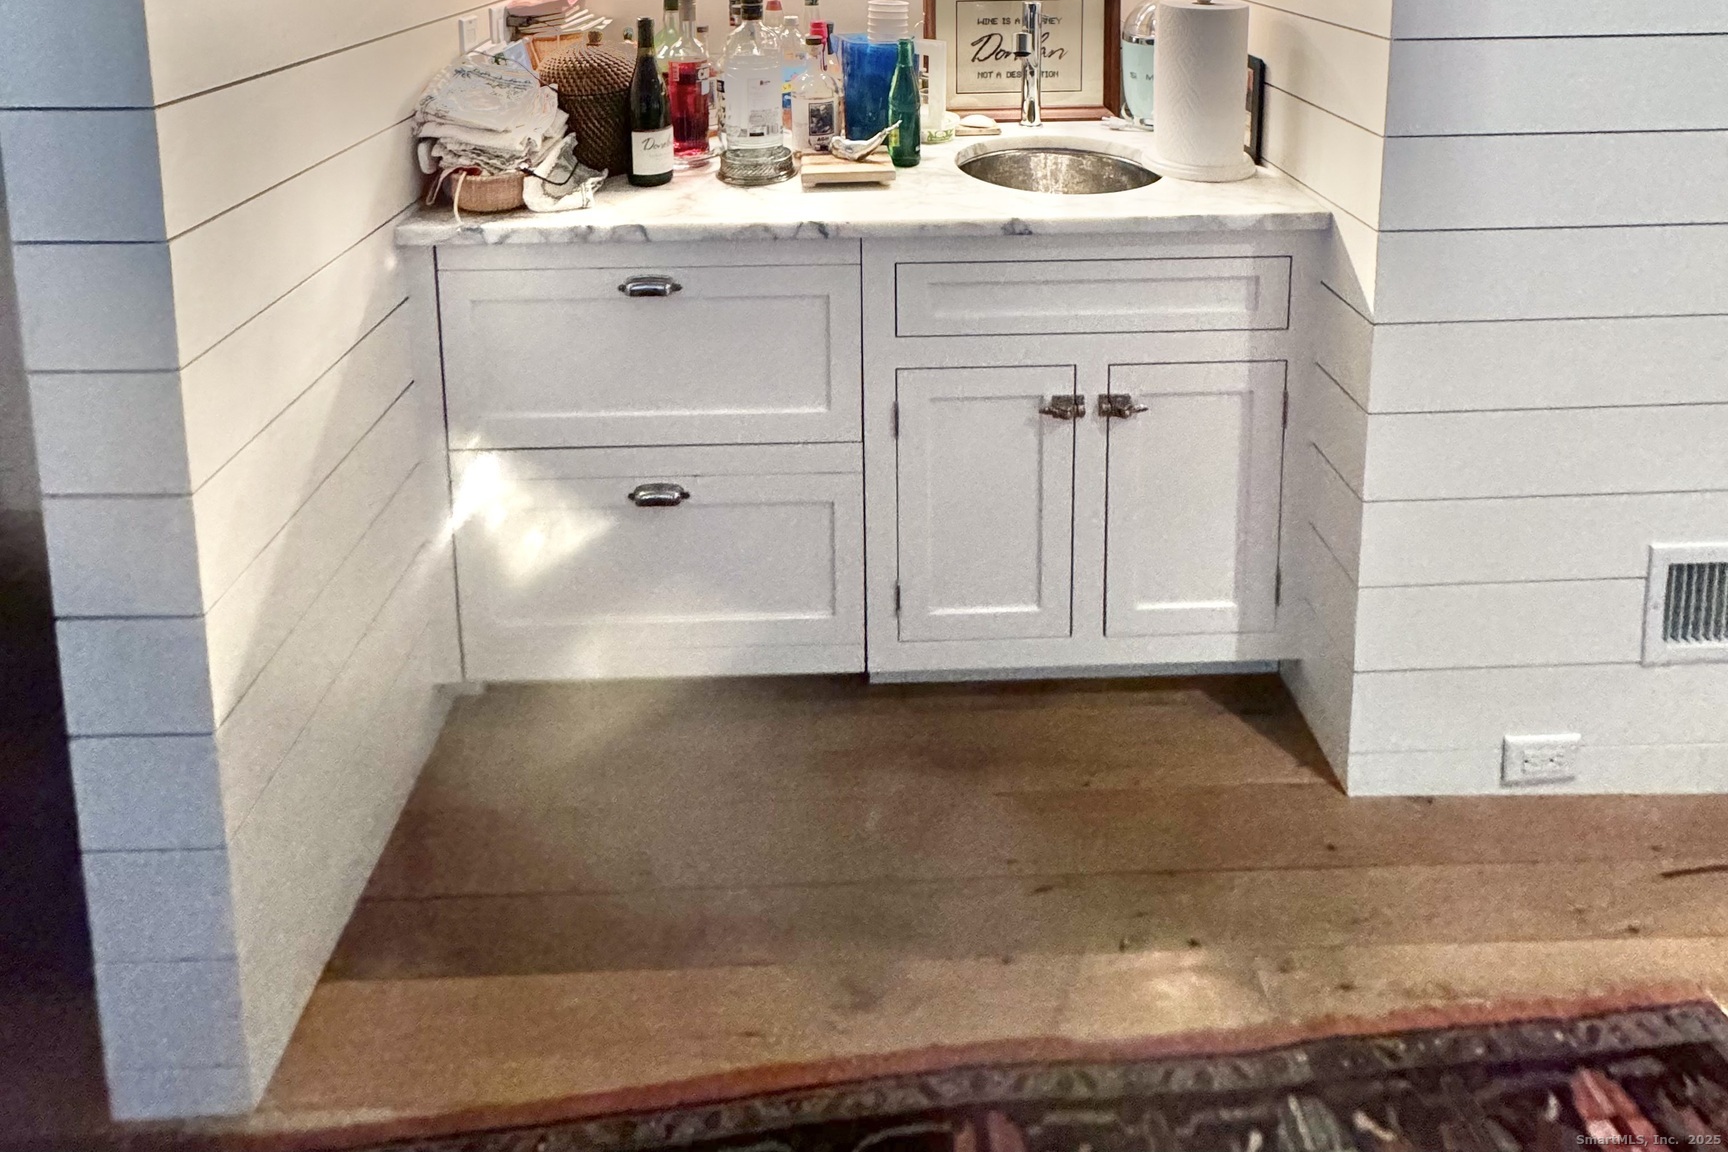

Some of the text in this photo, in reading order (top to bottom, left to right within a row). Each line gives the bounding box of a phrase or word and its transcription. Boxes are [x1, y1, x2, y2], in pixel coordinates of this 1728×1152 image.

[977, 17, 998, 25] WINE
[1002, 17, 1011, 25] IS
[1014, 17, 1020, 25] A
[977, 71, 993, 79] NOT
[1006, 70, 1059, 79] DESTION
